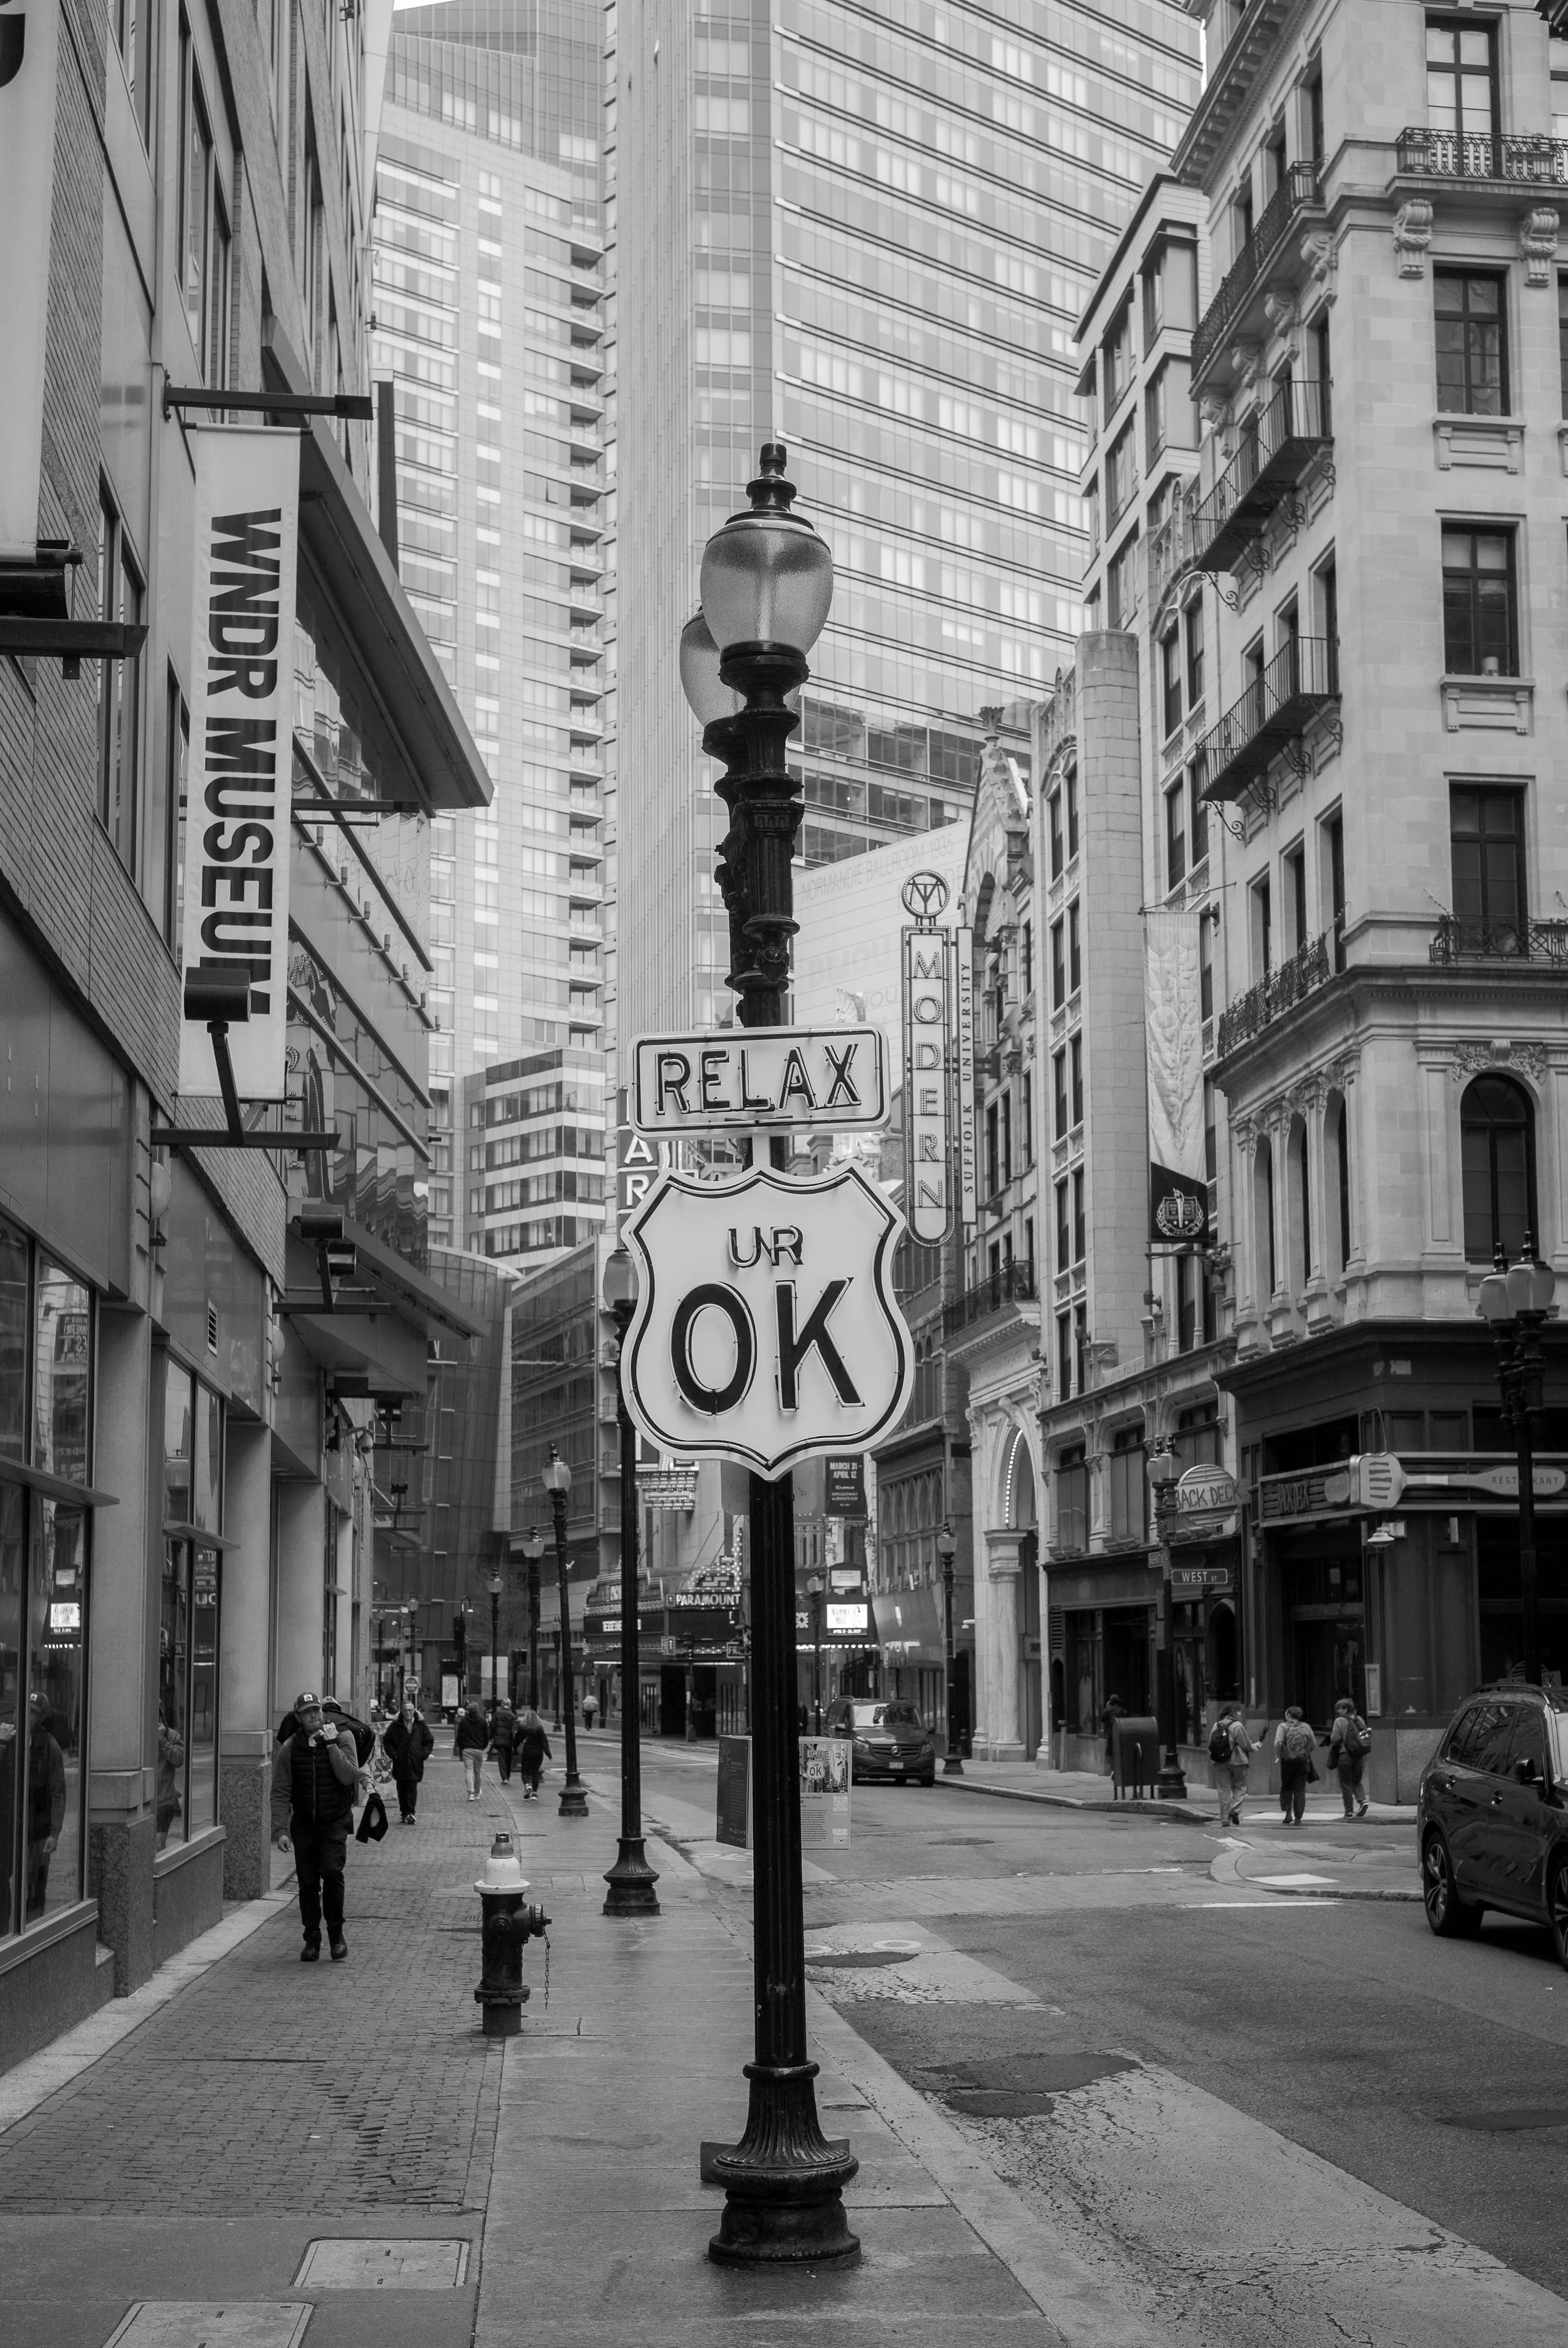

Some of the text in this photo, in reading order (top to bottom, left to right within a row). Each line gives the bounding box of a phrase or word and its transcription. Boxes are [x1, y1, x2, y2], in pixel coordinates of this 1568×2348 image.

[207, 507, 282, 699] WNDR
[802, 833, 954, 902] NORMANDIE BALLROOM 1935
[655, 1042, 862, 1116] RELAX
[913, 949, 943, 1208] MODERN
[961, 961, 975, 1194] SUFFOLK UNIVERSITY
[670, 1276, 866, 1417] OK
[830, 1462, 850, 1470] MARCH
[850, 1462, 858, 1470] 31
[833, 1471, 857, 1479] APRIL 12
[1492, 1476, 1559, 1485] RESTRANT
[1175, 1481, 1243, 1510] BACK DECK
[1181, 1571, 1208, 1583] WEST
[675, 1593, 741, 1607] PARAMOUNT
[810, 1766, 823, 1777] OK
